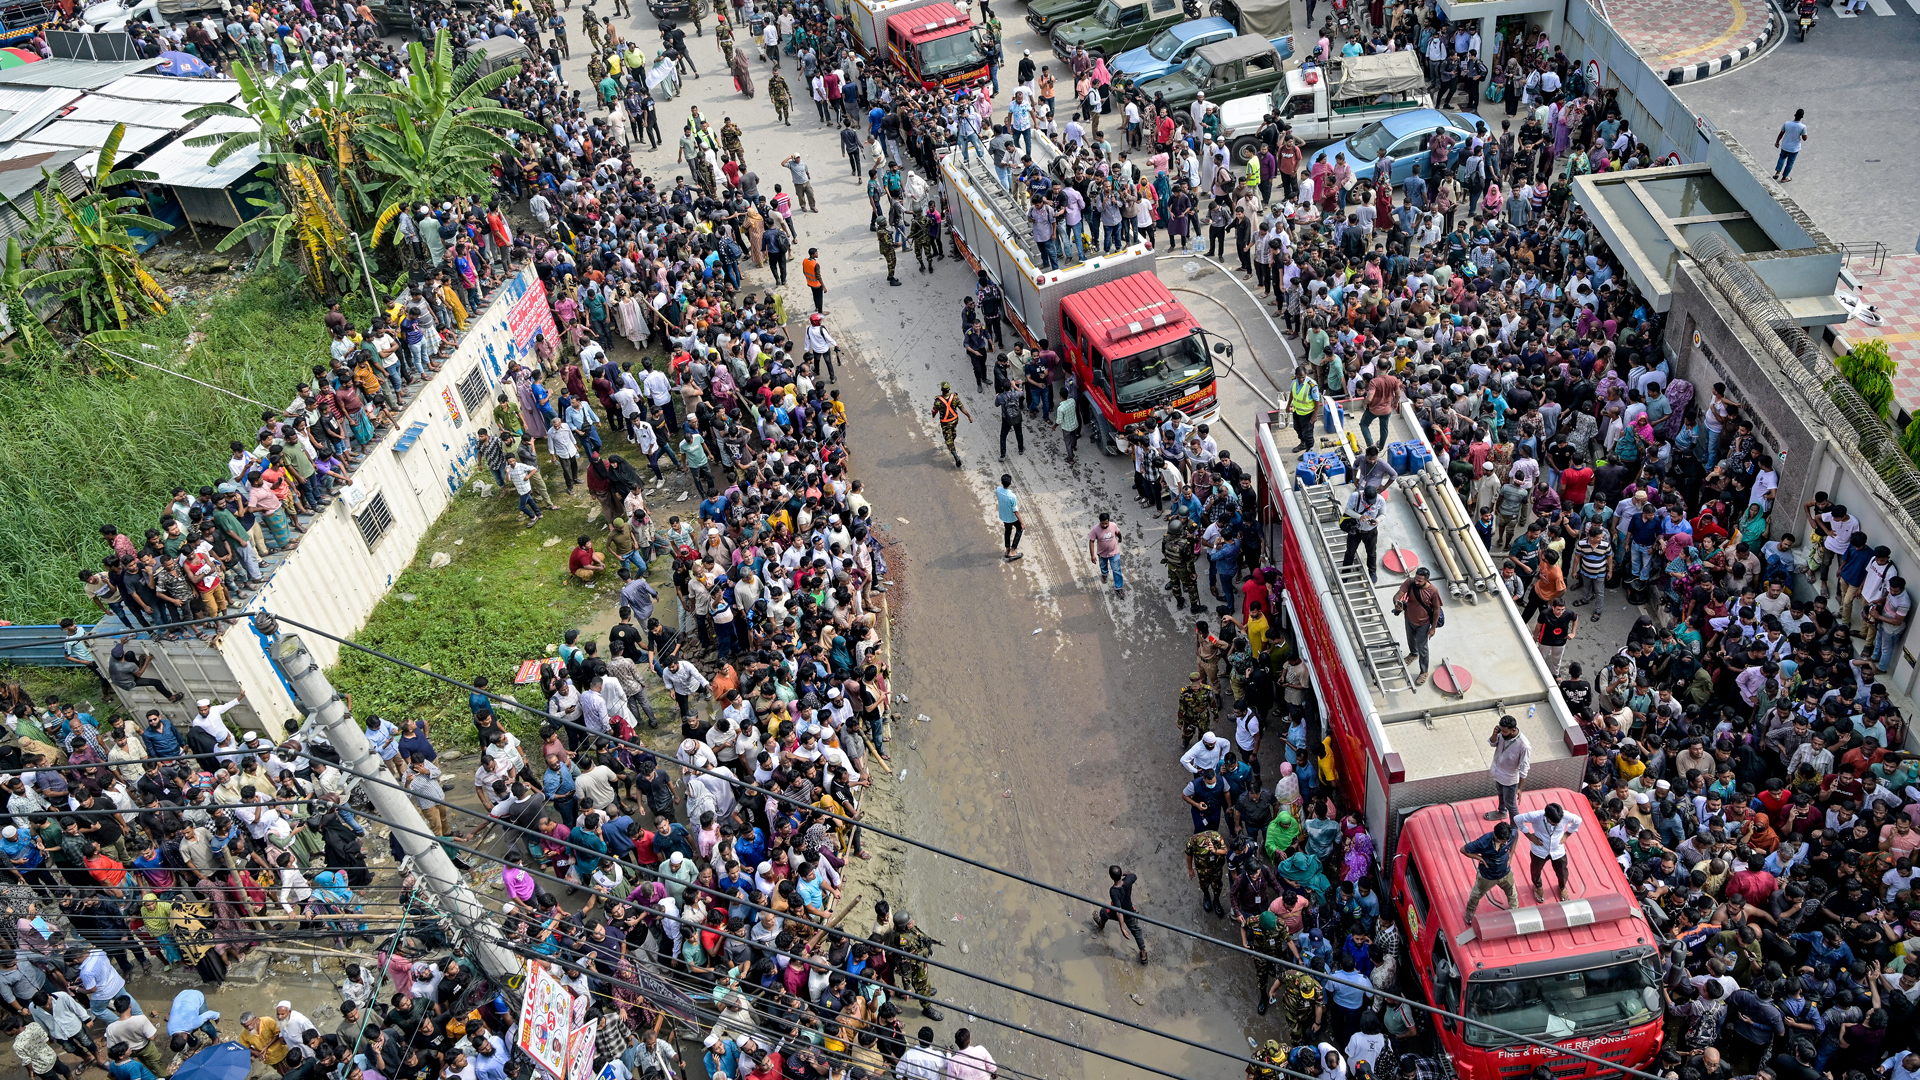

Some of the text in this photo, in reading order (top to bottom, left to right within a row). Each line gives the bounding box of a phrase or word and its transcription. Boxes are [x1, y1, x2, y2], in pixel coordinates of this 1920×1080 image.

[1177, 389, 1207, 407] RESPONSE
[1133, 409, 1147, 419] FIRE
[525, 972, 537, 1021] UCC
[1498, 1047, 1520, 1059] FIRE
[1522, 1048, 1531, 1056] &
[1533, 1043, 1573, 1055] RESUE
[1575, 1036, 1627, 1050] RESPONSE
